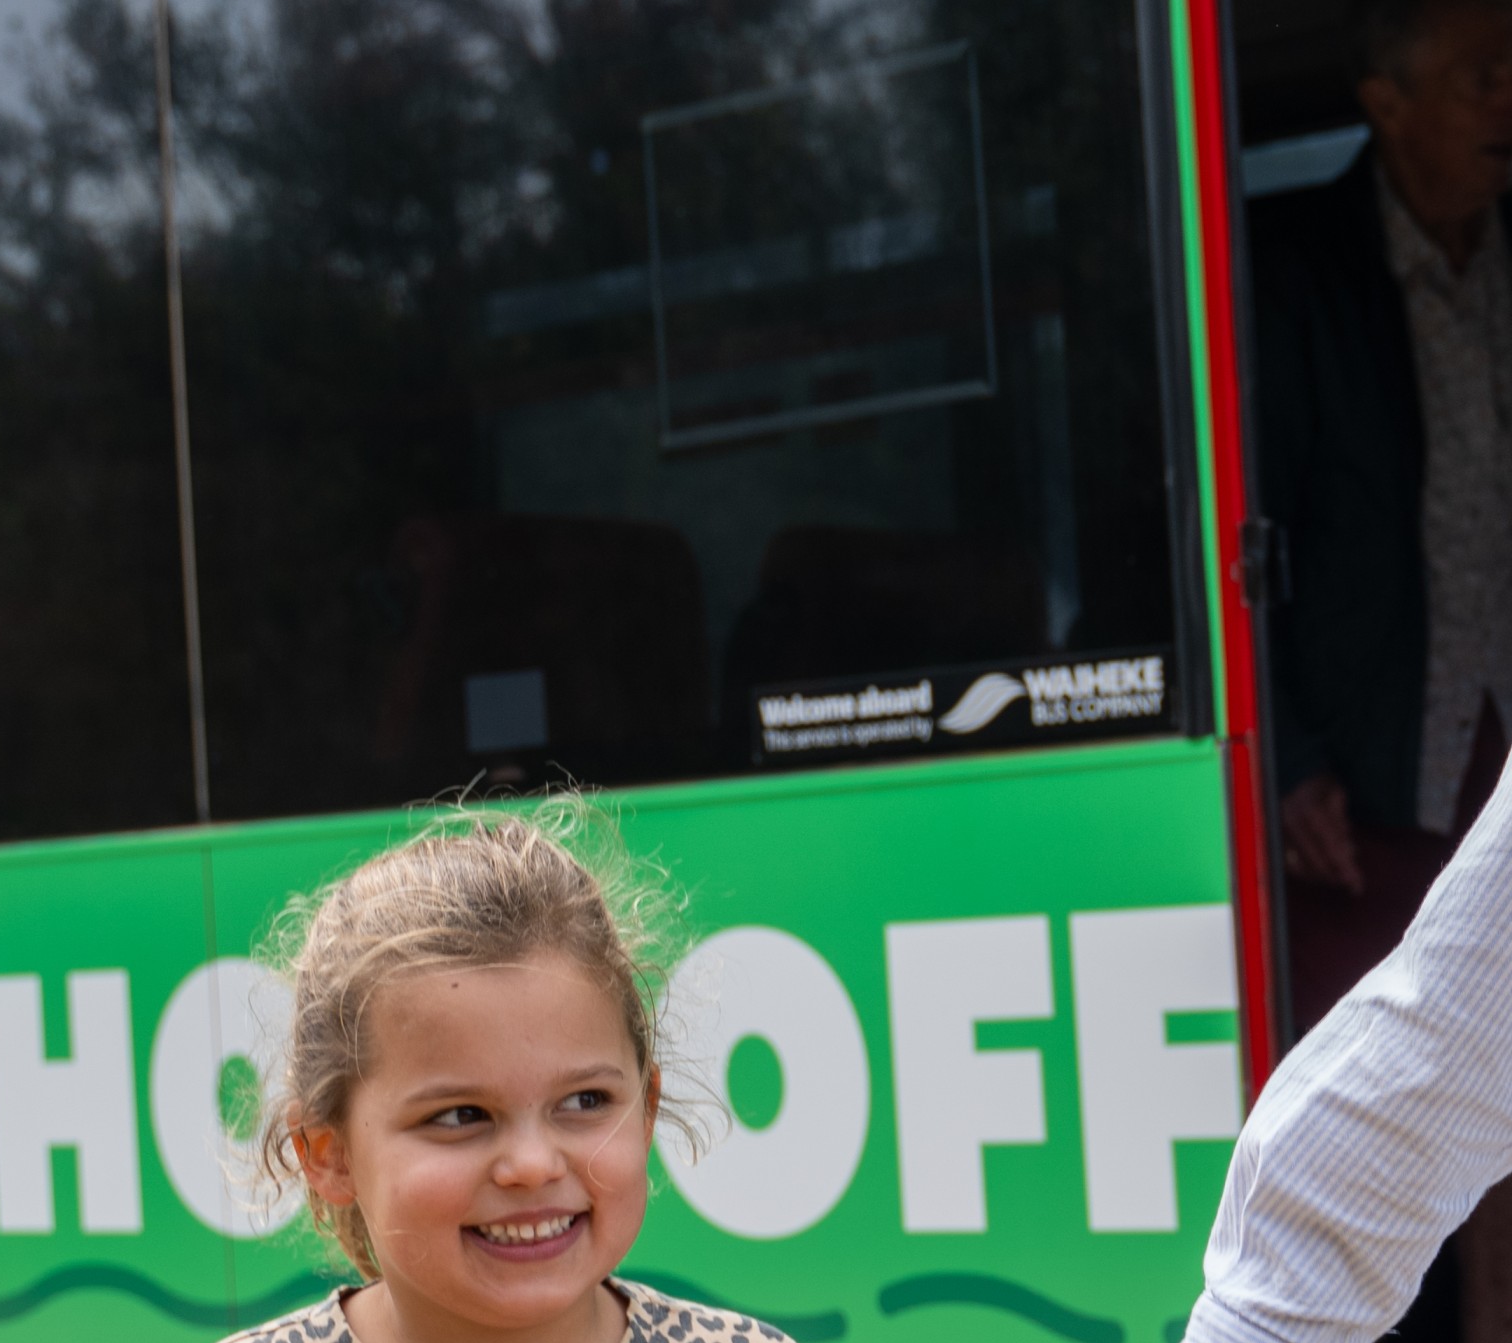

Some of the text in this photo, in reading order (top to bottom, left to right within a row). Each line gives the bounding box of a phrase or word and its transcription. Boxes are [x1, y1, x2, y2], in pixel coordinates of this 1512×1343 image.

[1022, 656, 1164, 702] WAIHEKE
[758, 679, 933, 728] Welcome aboard
[1031, 690, 1163, 726] BUS COMPANY
